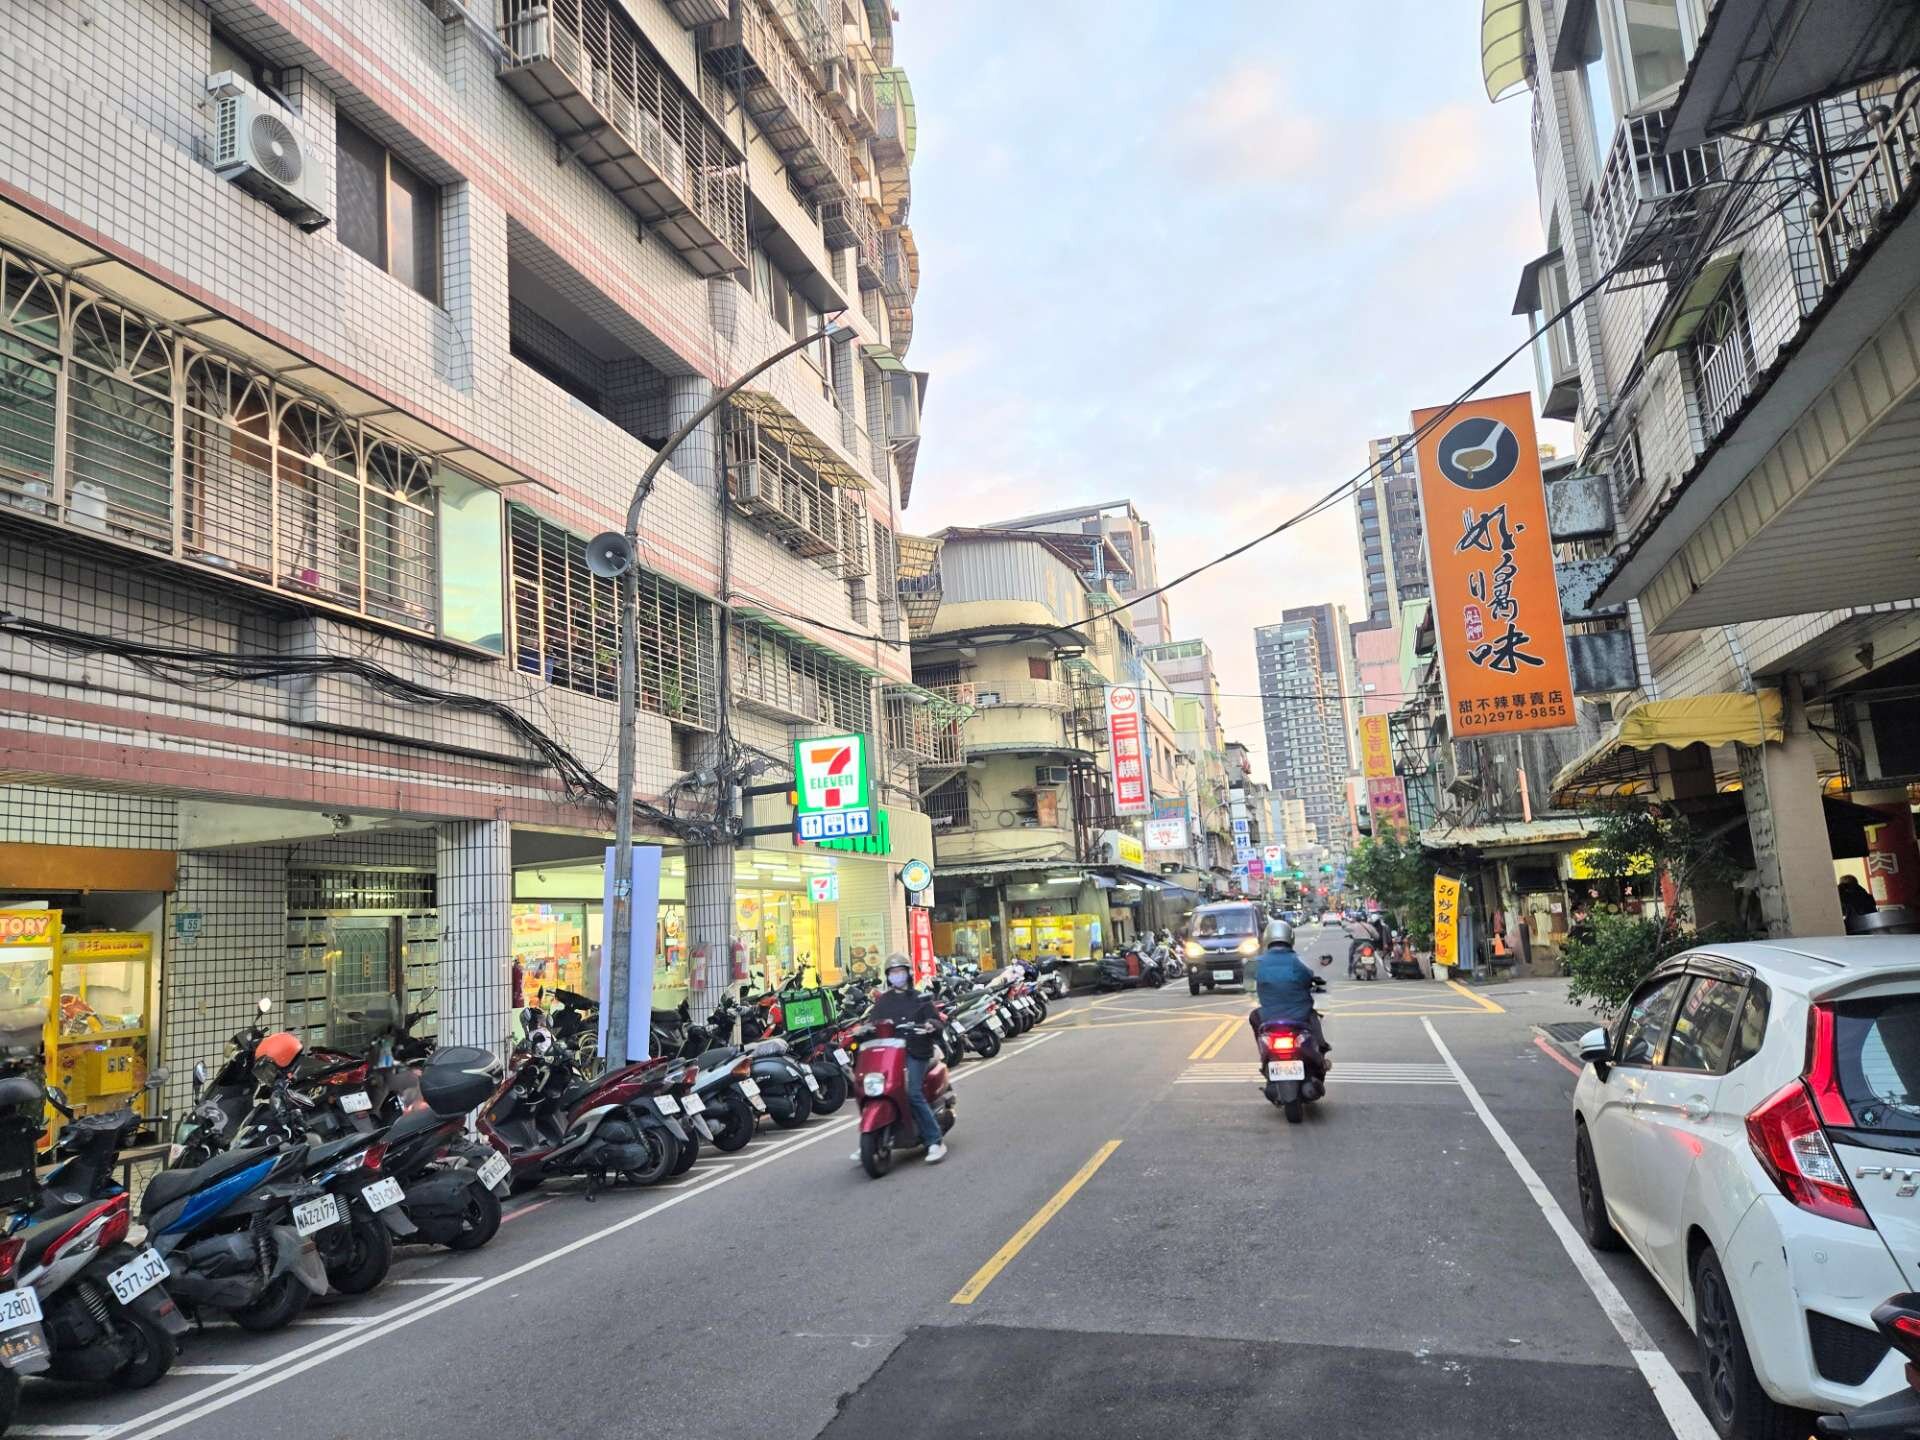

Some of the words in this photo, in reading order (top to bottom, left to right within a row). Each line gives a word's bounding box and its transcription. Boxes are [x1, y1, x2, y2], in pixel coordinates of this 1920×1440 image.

[1458, 690, 1563, 714] 甜不辣專賣店
[1460, 705, 1567, 729] (02)2978-9855
[810, 747, 852, 775] 7
[1113, 716, 1143, 800] 三陽機車
[296, 1201, 335, 1231] NAZ-2179
[114, 1257, 165, 1299] 577-JZY
